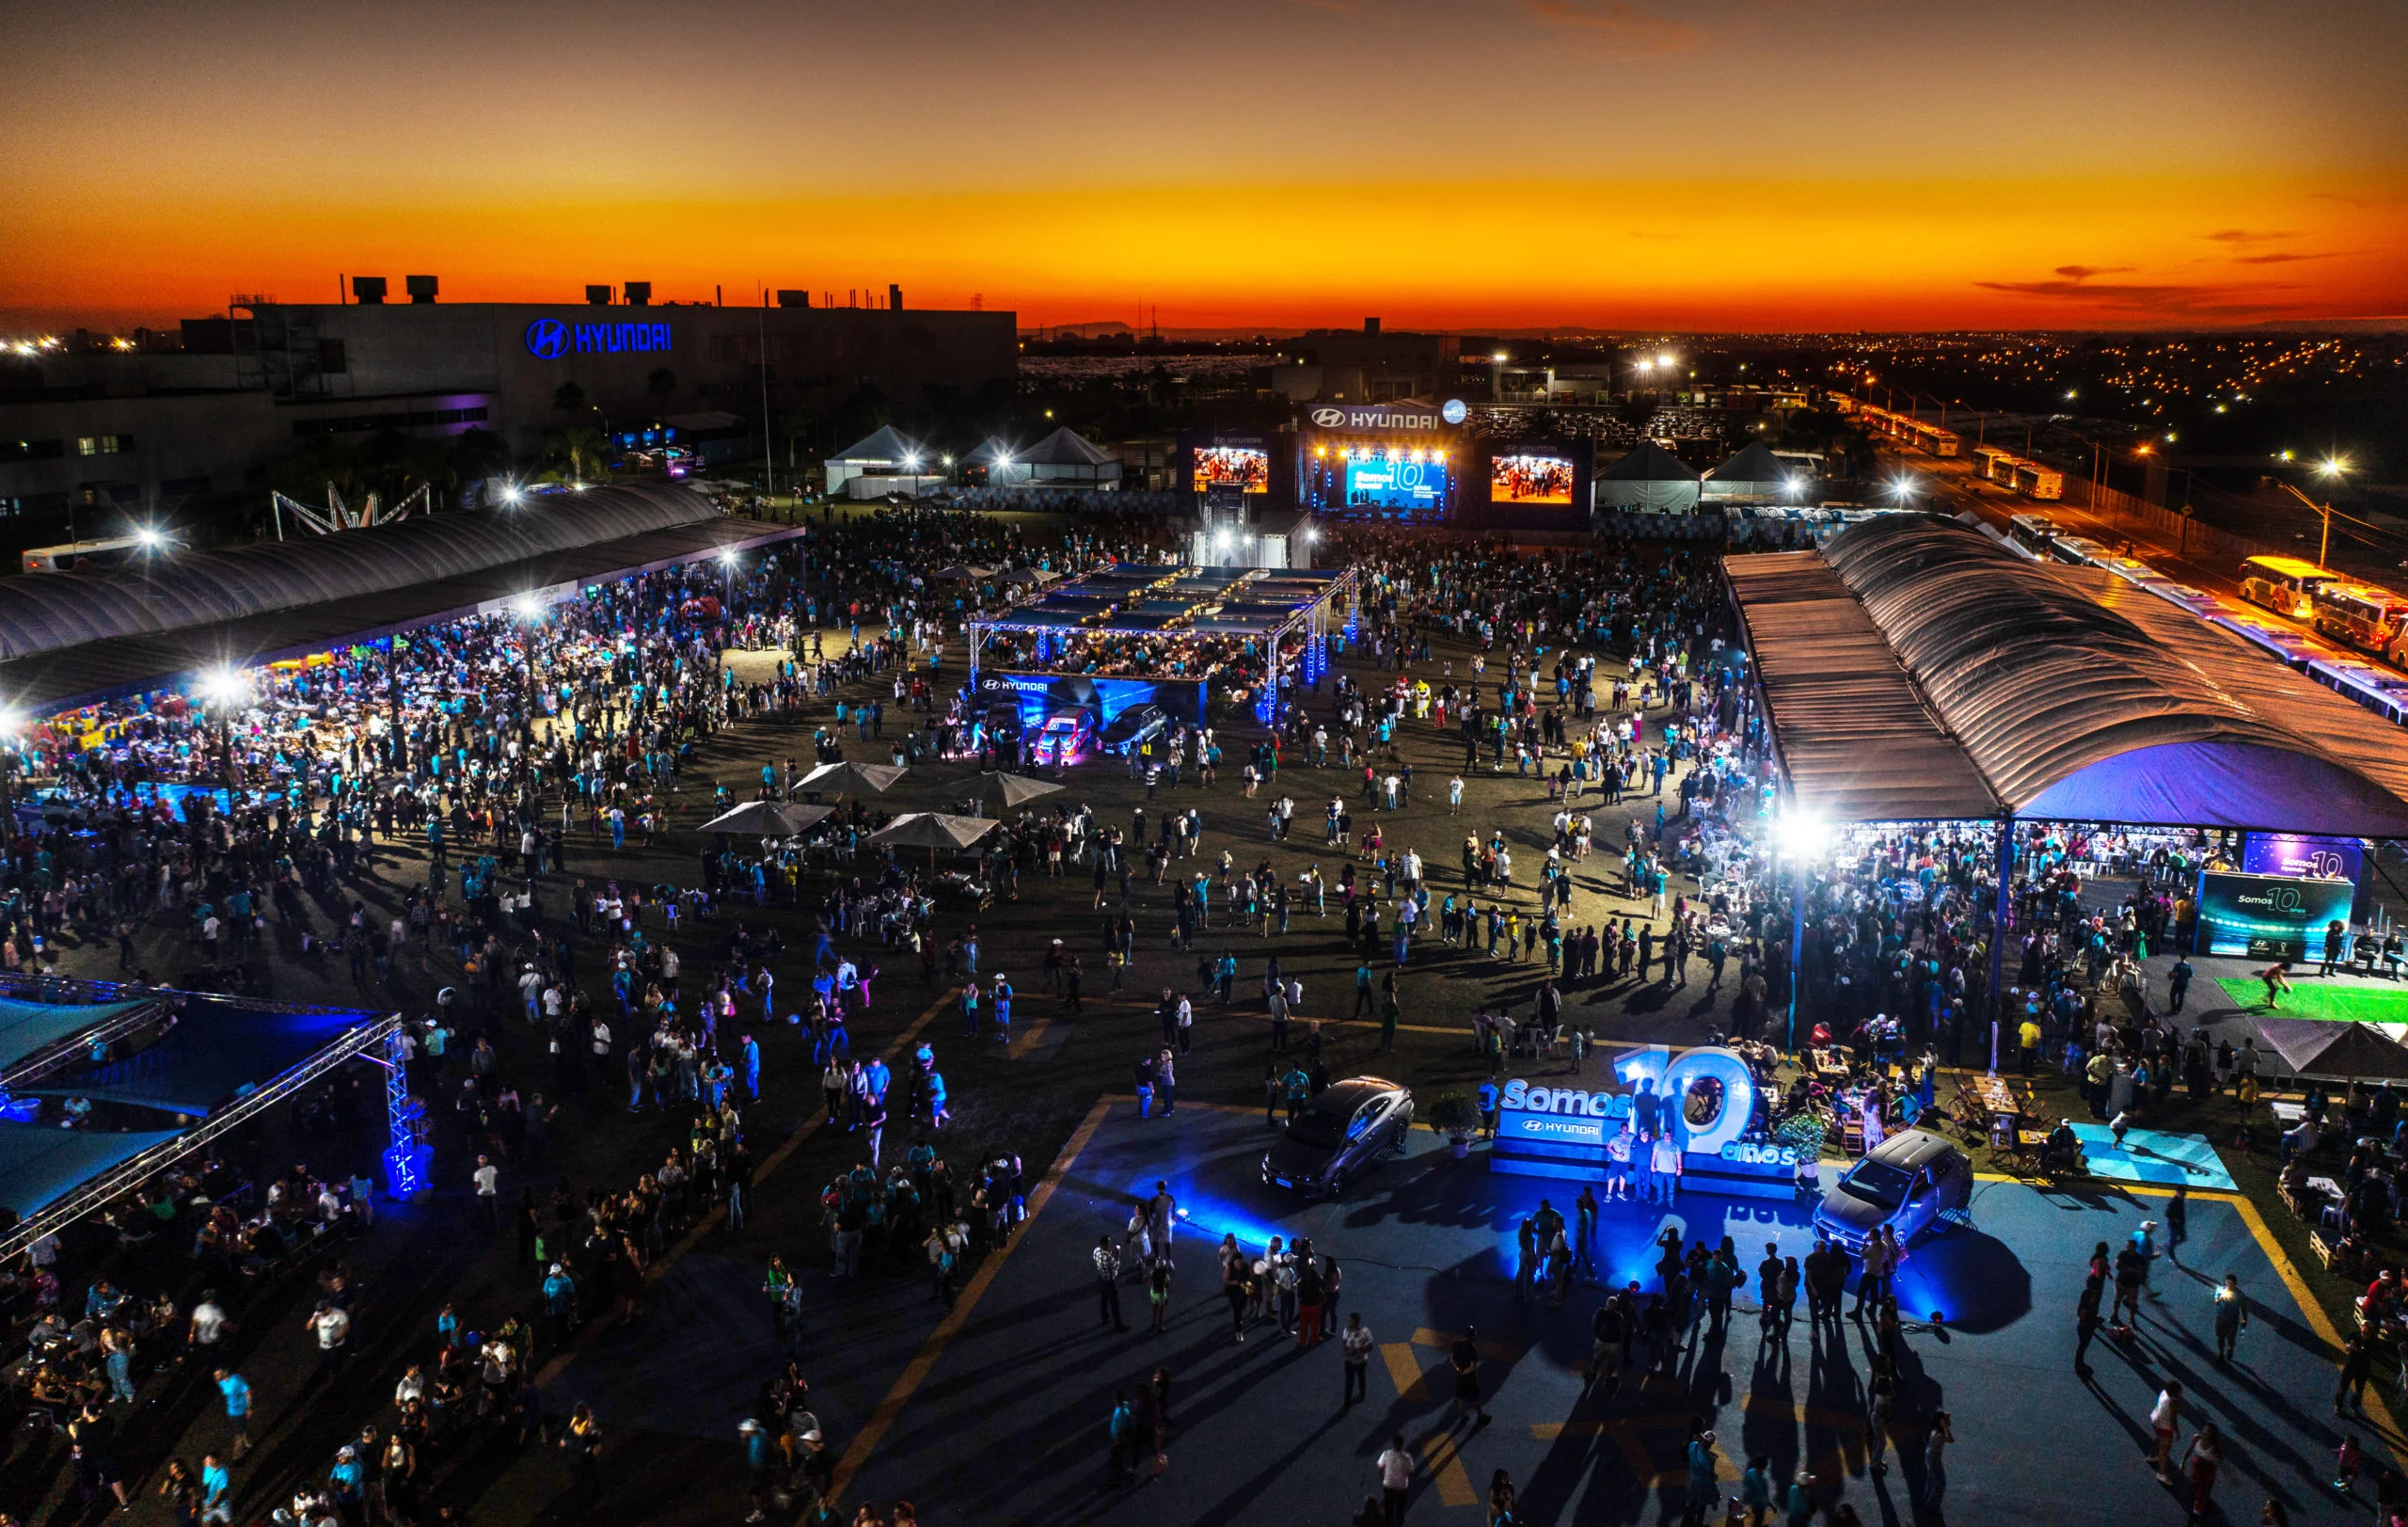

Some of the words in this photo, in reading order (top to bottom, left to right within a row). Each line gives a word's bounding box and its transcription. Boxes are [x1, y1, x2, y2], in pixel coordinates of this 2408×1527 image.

[575, 323, 672, 353] HYUNDAI
[1352, 412, 1438, 430] HYUNDAI
[1386, 460, 1423, 491] 10
[1002, 681, 1048, 692] HYUNDAI
[2281, 857, 2319, 869] Somos
[2311, 851, 2343, 879] 10
[2238, 895, 2273, 905] Somos
[2266, 887, 2301, 913] 10
[1499, 1078, 1633, 1119] Somos
[1613, 1044, 1753, 1154] 10
[1545, 1122, 1599, 1136] HYUNDAI
[1720, 1139, 1797, 1166] anos
